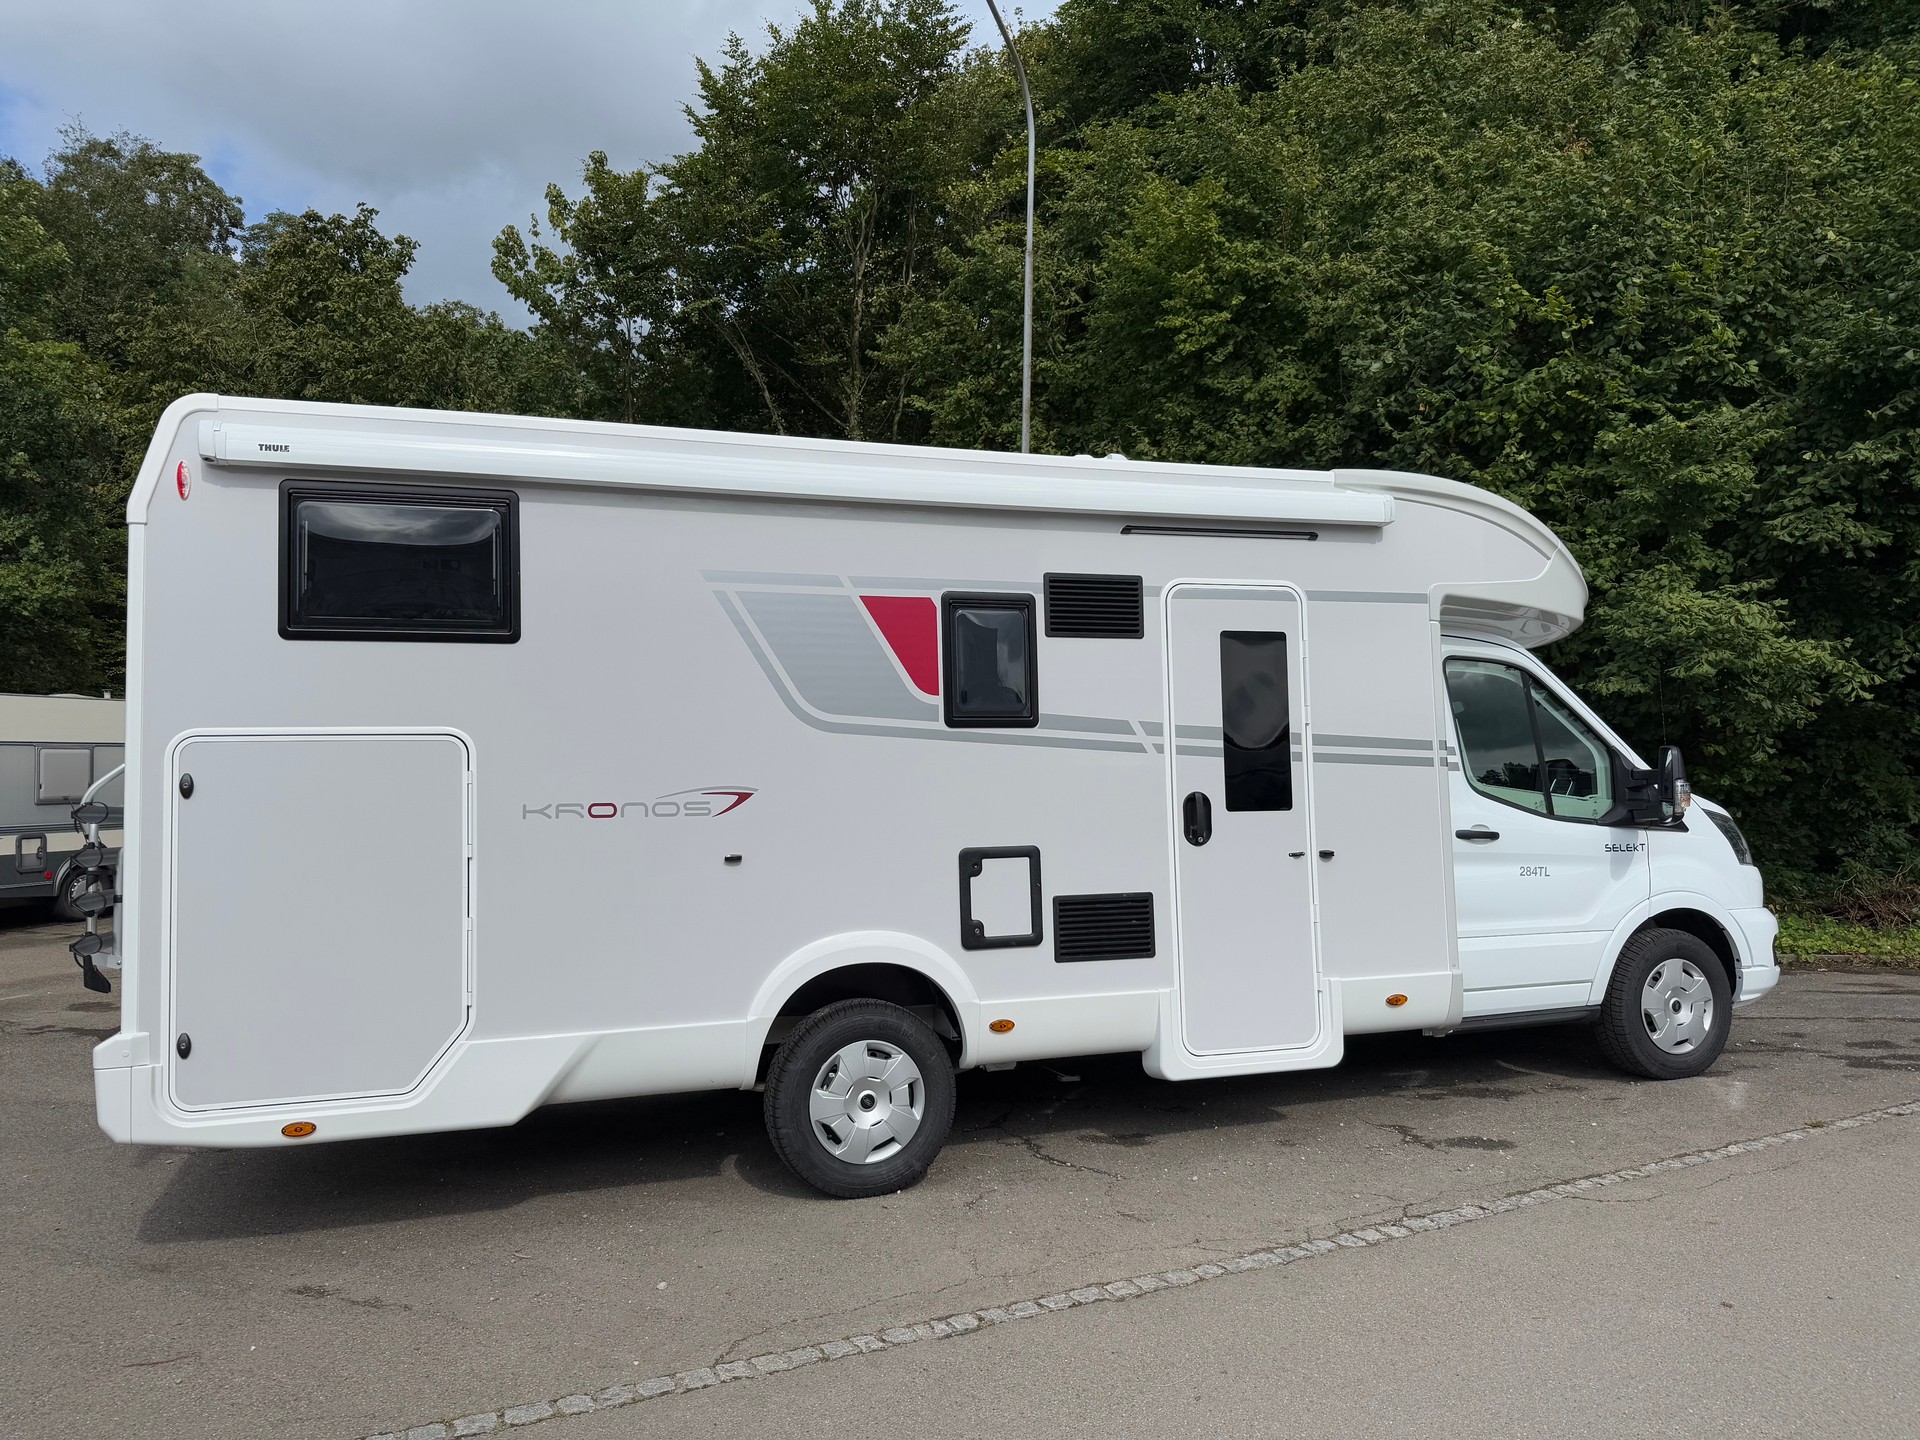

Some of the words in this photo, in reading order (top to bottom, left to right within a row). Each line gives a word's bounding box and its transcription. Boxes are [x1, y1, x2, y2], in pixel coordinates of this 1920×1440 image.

[257, 443, 290, 453] THULE
[1604, 843, 1646, 853] SELEKT
[1519, 866, 1551, 878] 284TL
